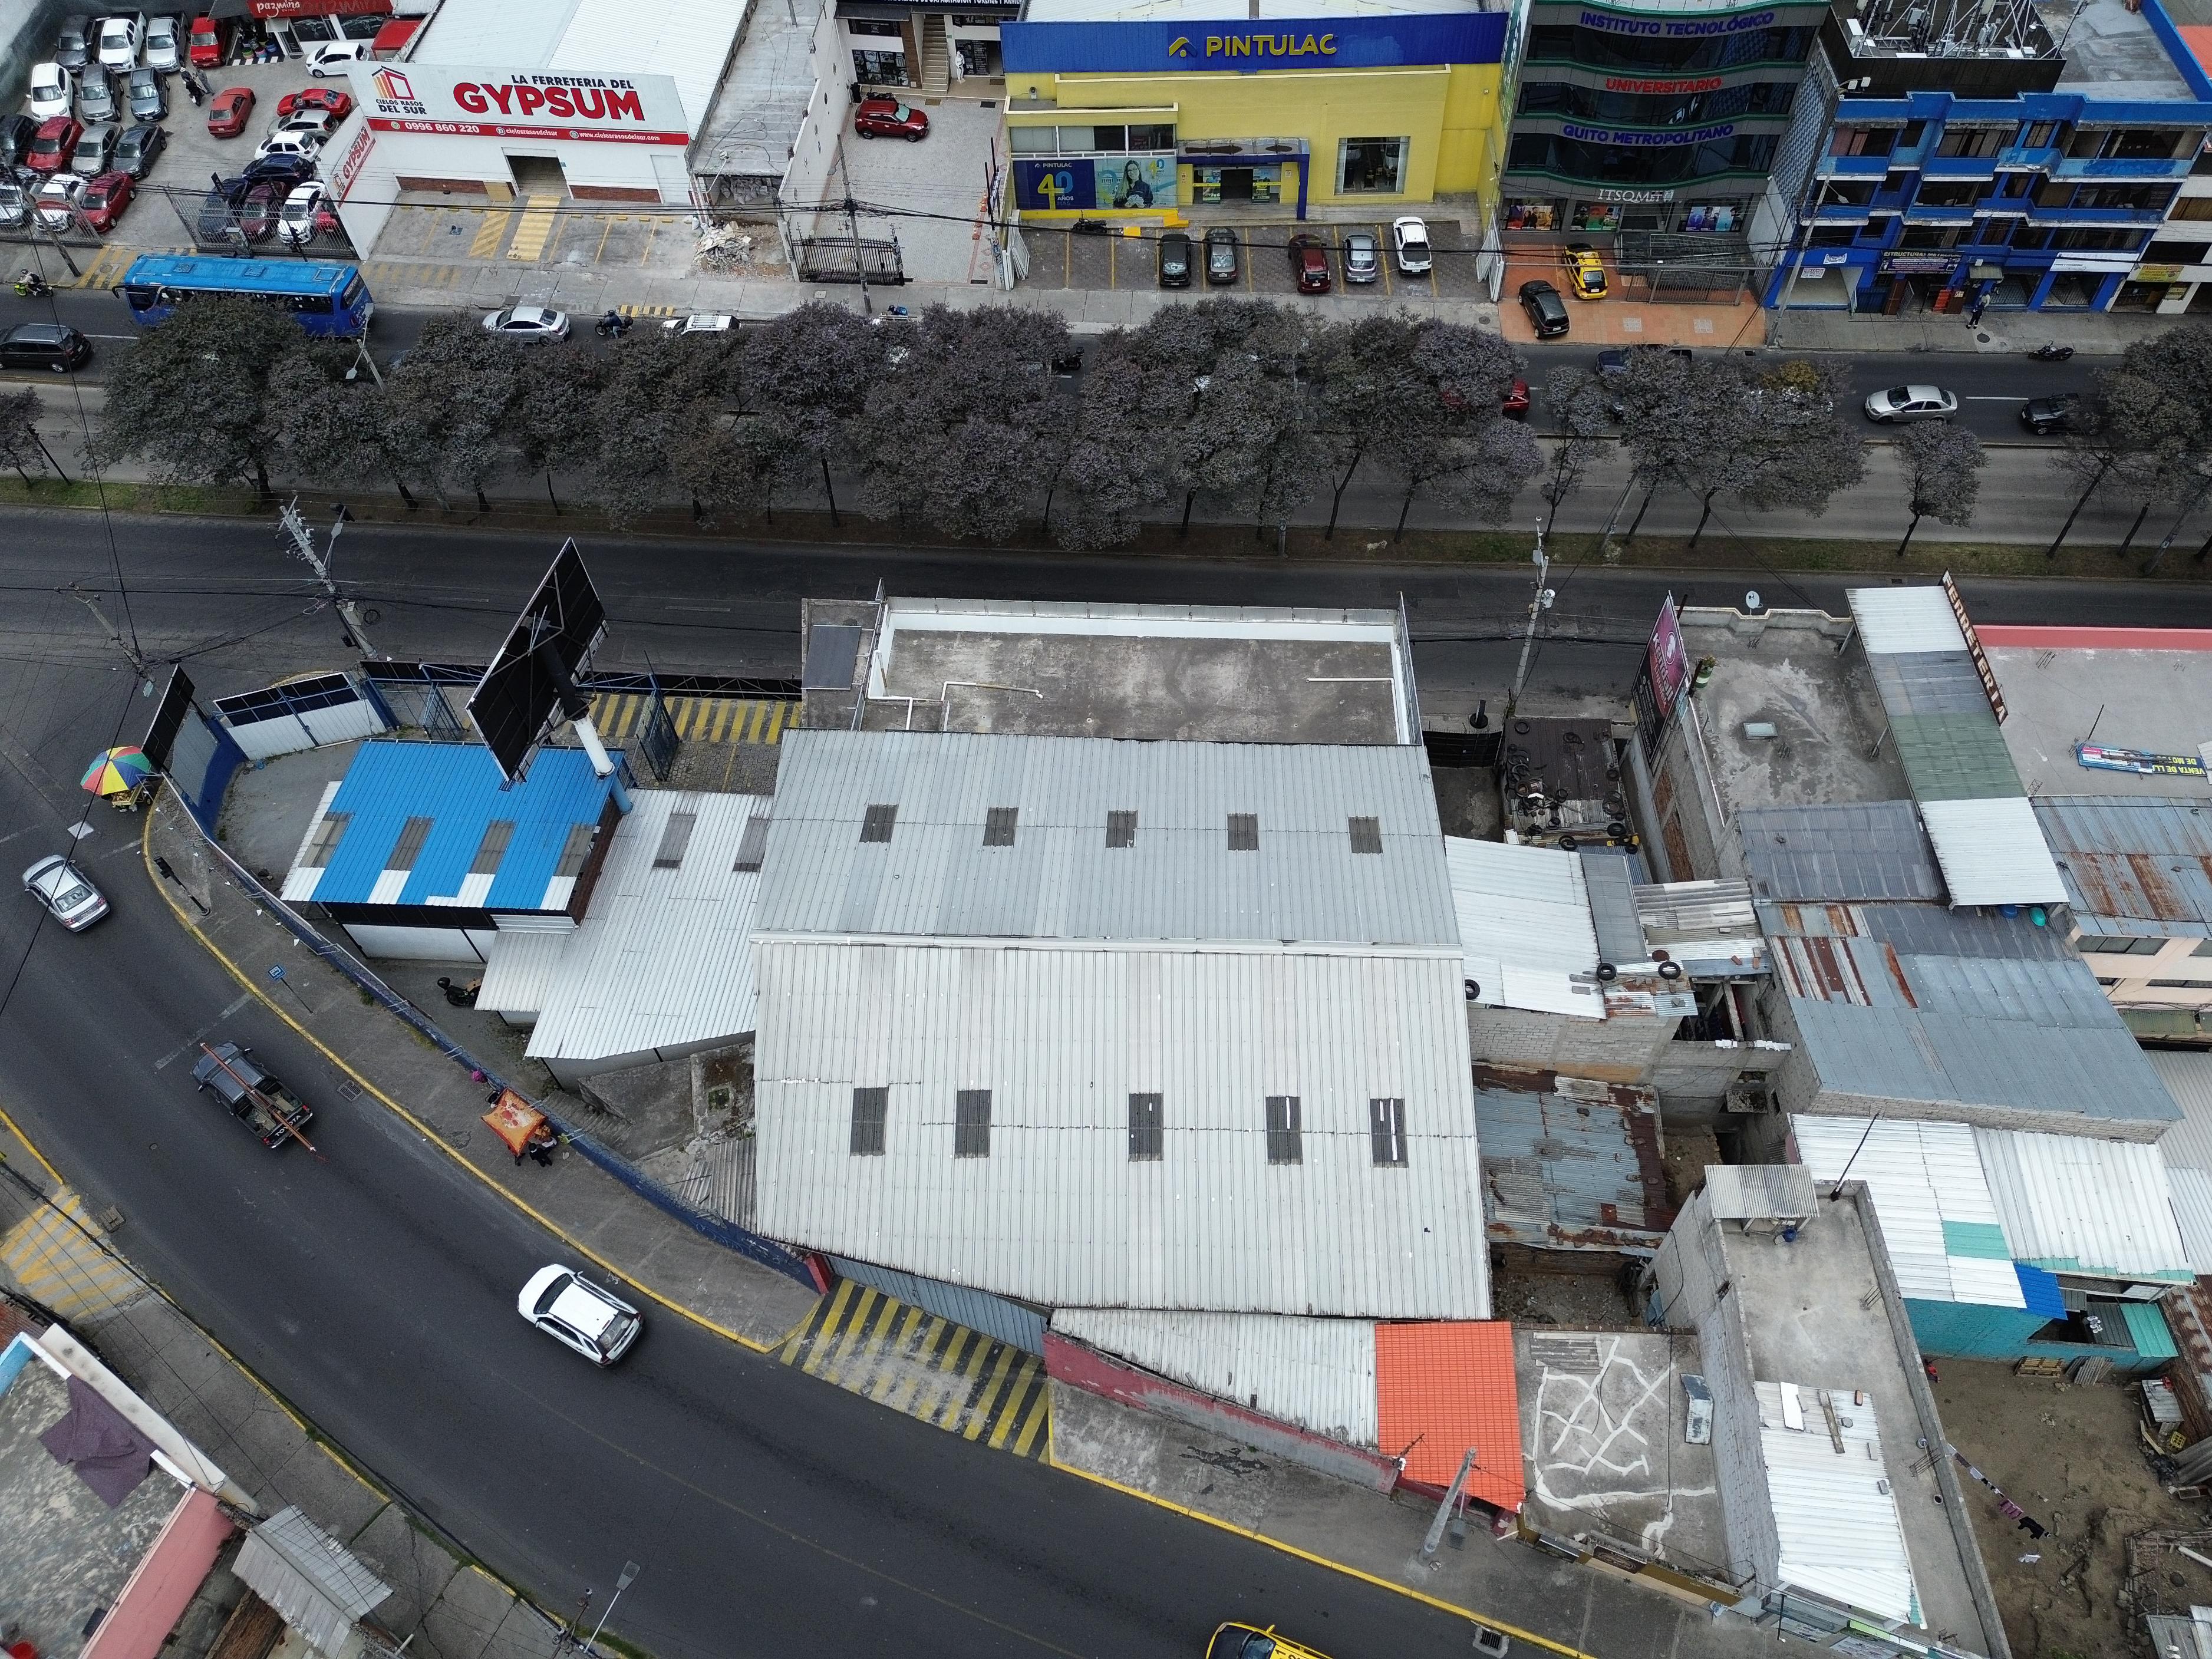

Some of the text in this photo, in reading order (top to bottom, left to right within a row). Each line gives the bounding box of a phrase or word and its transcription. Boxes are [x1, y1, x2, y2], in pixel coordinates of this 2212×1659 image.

[1580, 12, 1775, 35] INSTITUTO TECNOLÓGICO
[1206, 34, 1337, 57] PINTULAC
[511, 75, 634, 89] LA FERRETERIA DEL
[1606, 76, 1722, 93] UNIVERSITARIO
[378, 104, 400, 113] DEL
[453, 83, 645, 121] GYPSUM
[405, 122, 480, 133] 0996 860 220
[1563, 124, 1733, 144] QUITO METROPOLITANO
[342, 129, 371, 179] GYPSUM
[1942, 570, 2005, 723] FERRETERIA
[1653, 632, 1673, 701] Kendall
[2167, 765, 2178, 773] DE
[2178, 766, 2206, 775] VENTA
